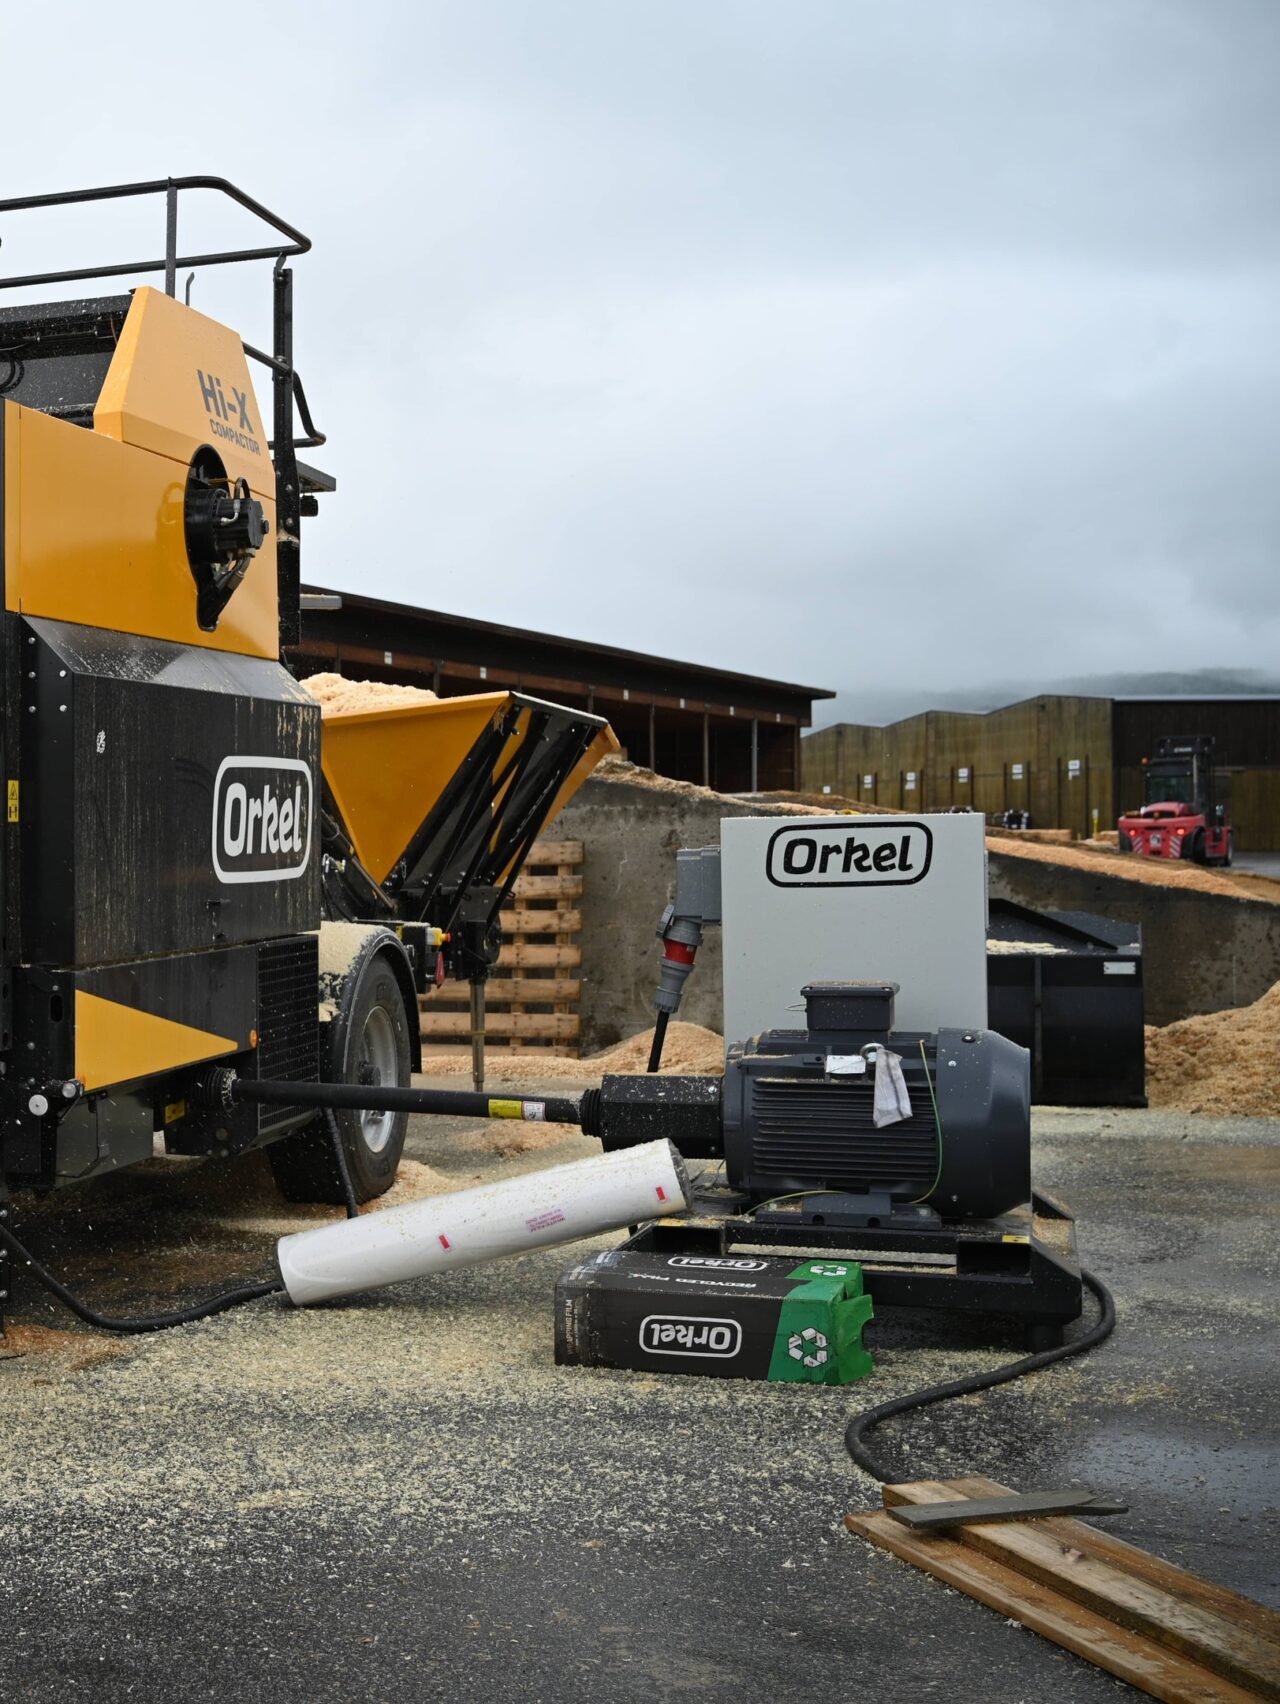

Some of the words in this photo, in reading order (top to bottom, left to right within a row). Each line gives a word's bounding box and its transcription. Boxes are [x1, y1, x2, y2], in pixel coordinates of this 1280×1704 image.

[197, 369, 254, 434] Hi-X
[210, 419, 261, 456] COMPACTOR
[223, 782, 302, 857] Orkel
[783, 835, 913, 875] Orkel
[679, 1257, 756, 1268] Orkel
[675, 1278, 756, 1288] RECYCLED
[565, 1299, 573, 1317] FILM
[650, 1323, 731, 1351] Orkel
